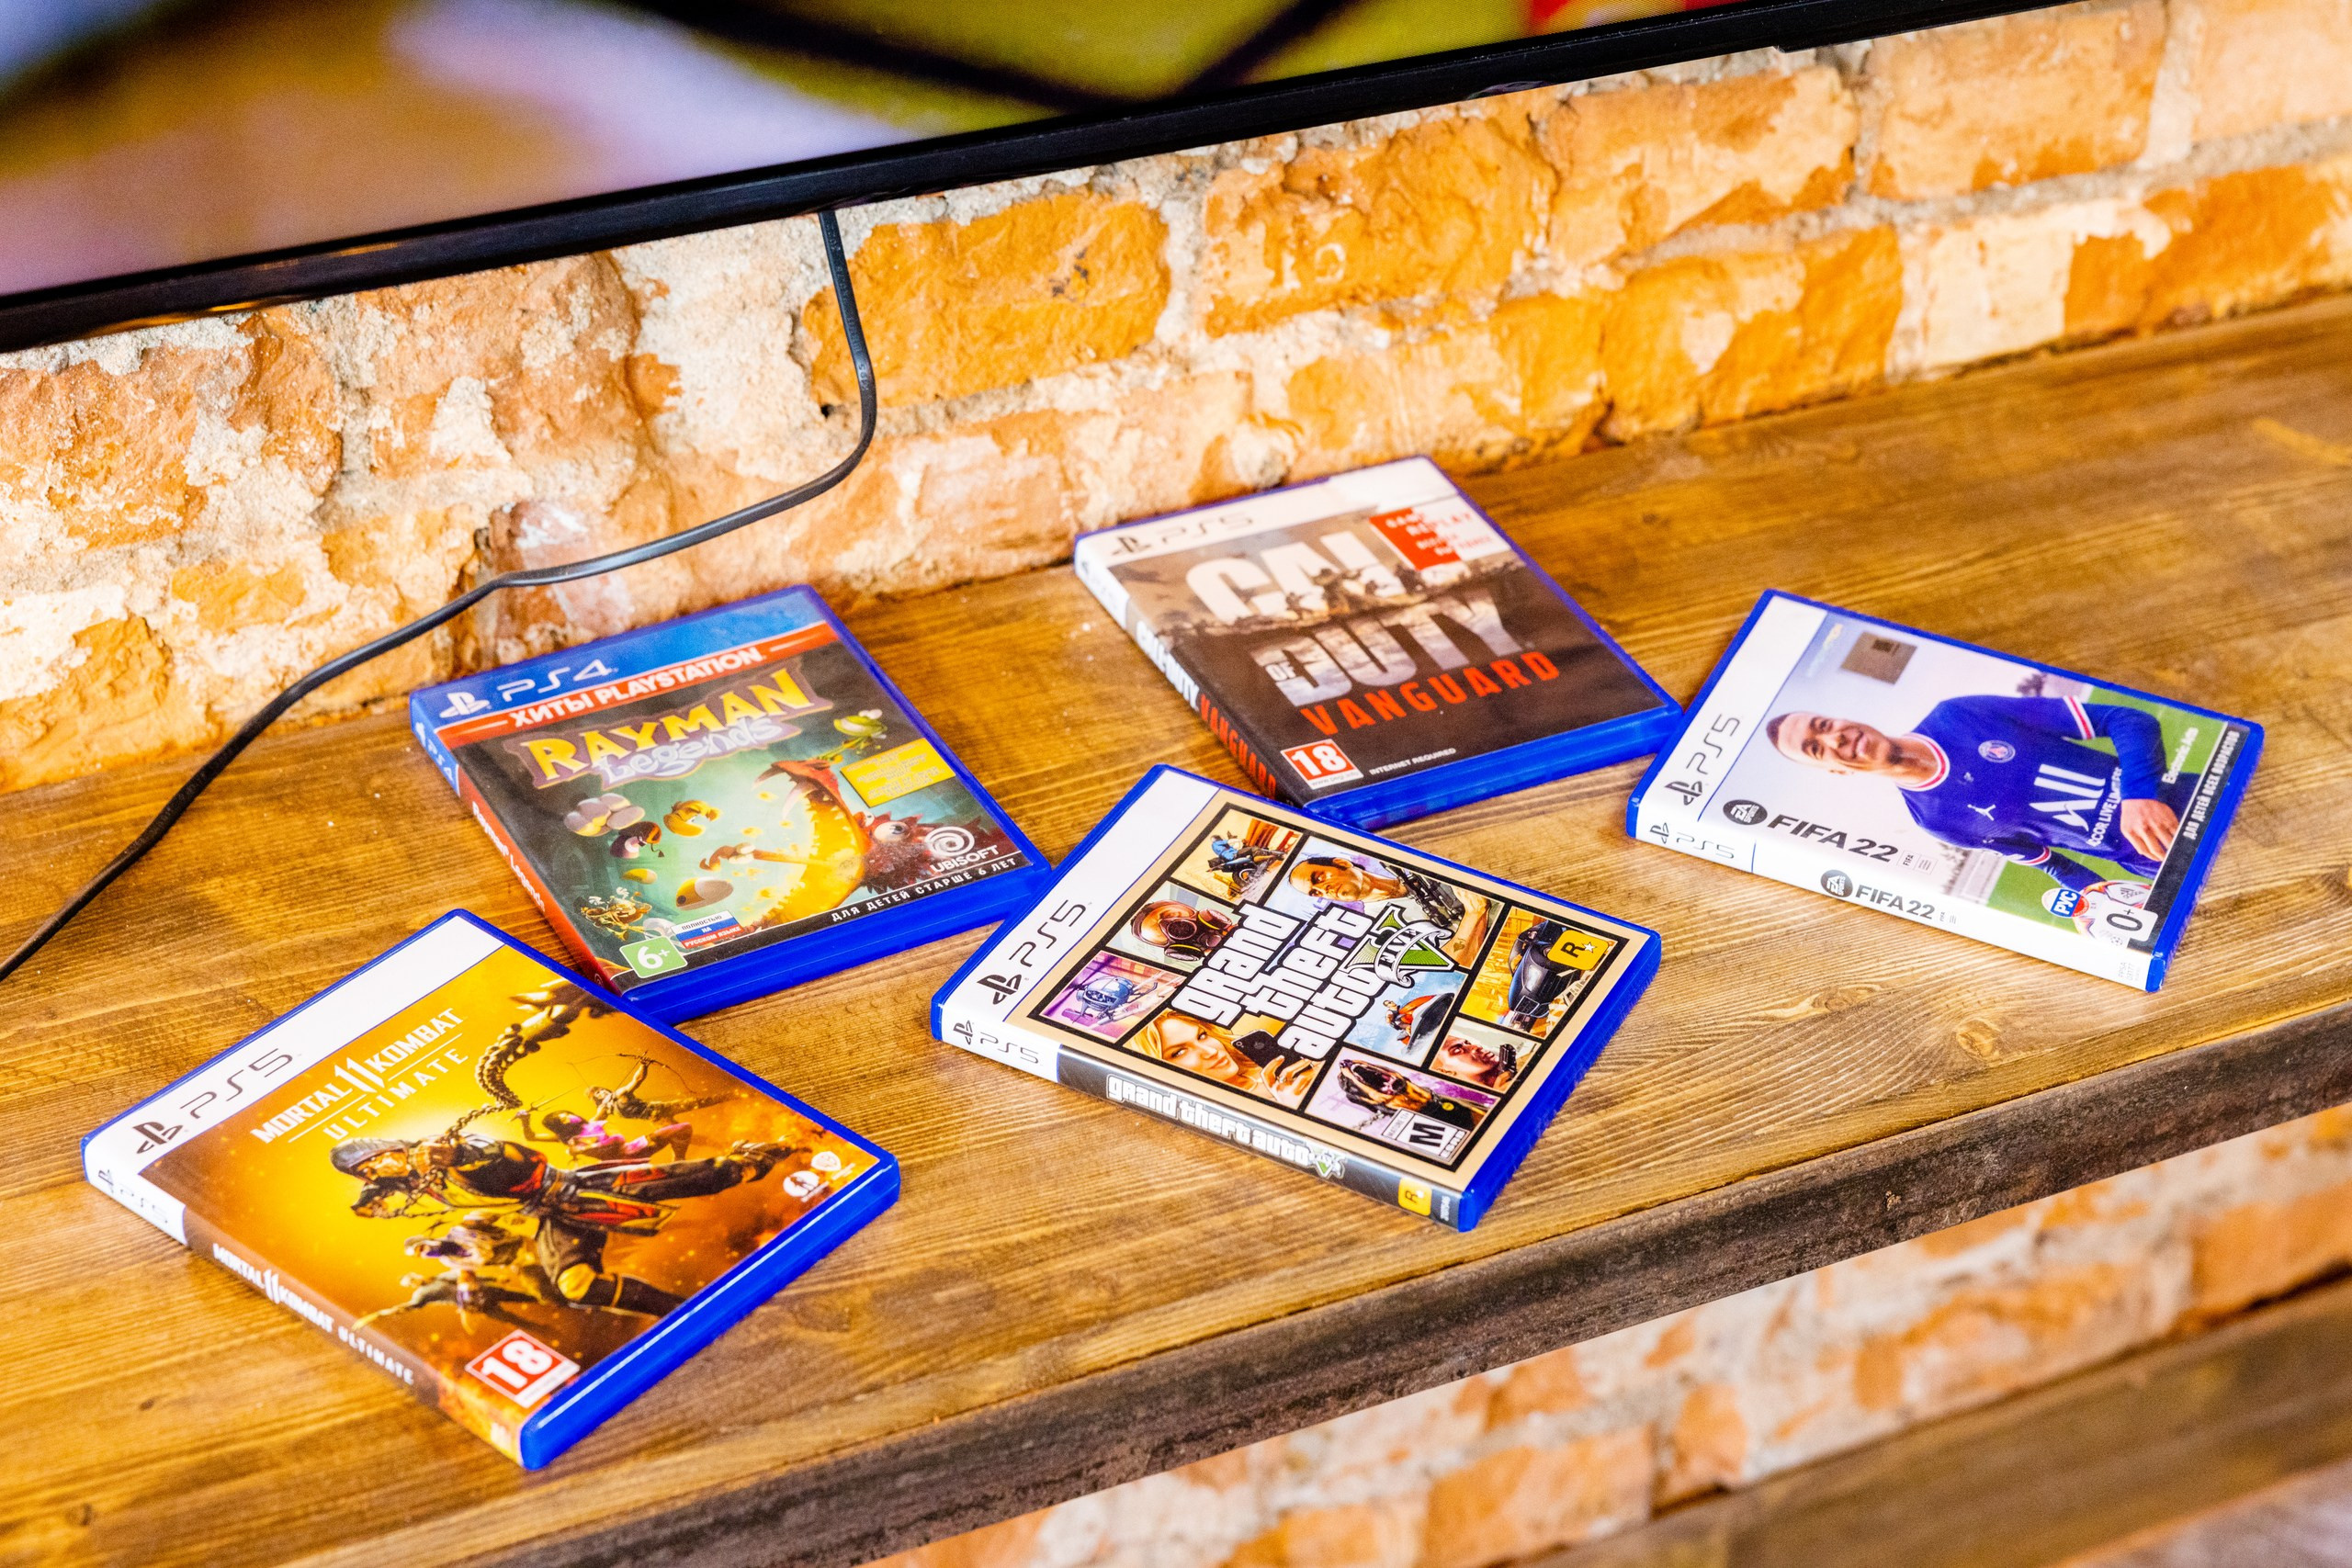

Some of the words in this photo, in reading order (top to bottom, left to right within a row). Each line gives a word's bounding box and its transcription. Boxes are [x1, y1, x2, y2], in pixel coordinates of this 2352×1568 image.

[1155, 511, 1253, 544] PS5
[1185, 530, 1471, 626] CAL
[1250, 591, 1523, 707] DUTY
[497, 659, 613, 702] PS4
[510, 694, 594, 727] ХИТЫ
[594, 646, 765, 705] PLAYSTATION
[1265, 661, 1296, 682] OF
[1299, 650, 1560, 736] VANGUARD
[520, 668, 816, 781] RAYMAN
[597, 716, 783, 784] Legends
[1290, 744, 1348, 777] 18
[1368, 759, 1411, 775] INTERNET
[1412, 747, 1457, 765] REQUIRED
[1685, 714, 1741, 775] PS5
[2201, 773, 2222, 796] ВСЕХ
[1729, 803, 1751, 823] EA
[2097, 800, 2118, 824] LIVE
[2190, 795, 2211, 822] ДЕТЕЙ
[1675, 831, 1736, 859] PS5
[1767, 814, 1848, 850] FIFA
[1848, 838, 1899, 863] 22
[2182, 820, 2199, 840] ДЛЯ
[930, 844, 1001, 874] UBISOFT
[831, 906, 860, 922] ДЛЯ
[866, 889, 910, 912] ДЕТЕЙ
[915, 871, 973, 896] СТАРШЕ
[978, 867, 987, 876] 6
[990, 858, 1017, 873] ЛЕТ
[1854, 884, 1905, 912] FIFA
[1905, 899, 1936, 920] 22
[2052, 890, 2078, 915] РУС
[684, 934, 717, 947] РУССКОМ
[718, 926, 742, 937] ЯЗЫКЕ
[701, 926, 712, 934] НА
[1008, 899, 1087, 968] PS5
[2106, 908, 2143, 931] 0+
[638, 945, 671, 969] 6+
[1380, 928, 1420, 965] FIVE
[1276, 967, 1389, 1060] auto
[979, 1031, 1039, 1065] PS5
[180, 1048, 293, 1119] PS5
[250, 1082, 354, 1144] MORTAL
[334, 1057, 385, 1093] 11
[365, 1007, 464, 1074] KOMBAT
[322, 1048, 469, 1141] ULTIMATE
[1408, 1122, 1446, 1147] M
[212, 1243, 266, 1289] MORTAL
[278, 1285, 334, 1333] KOMBAT
[337, 1325, 414, 1386] ULTIMATE
[481, 1339, 553, 1390] 18
